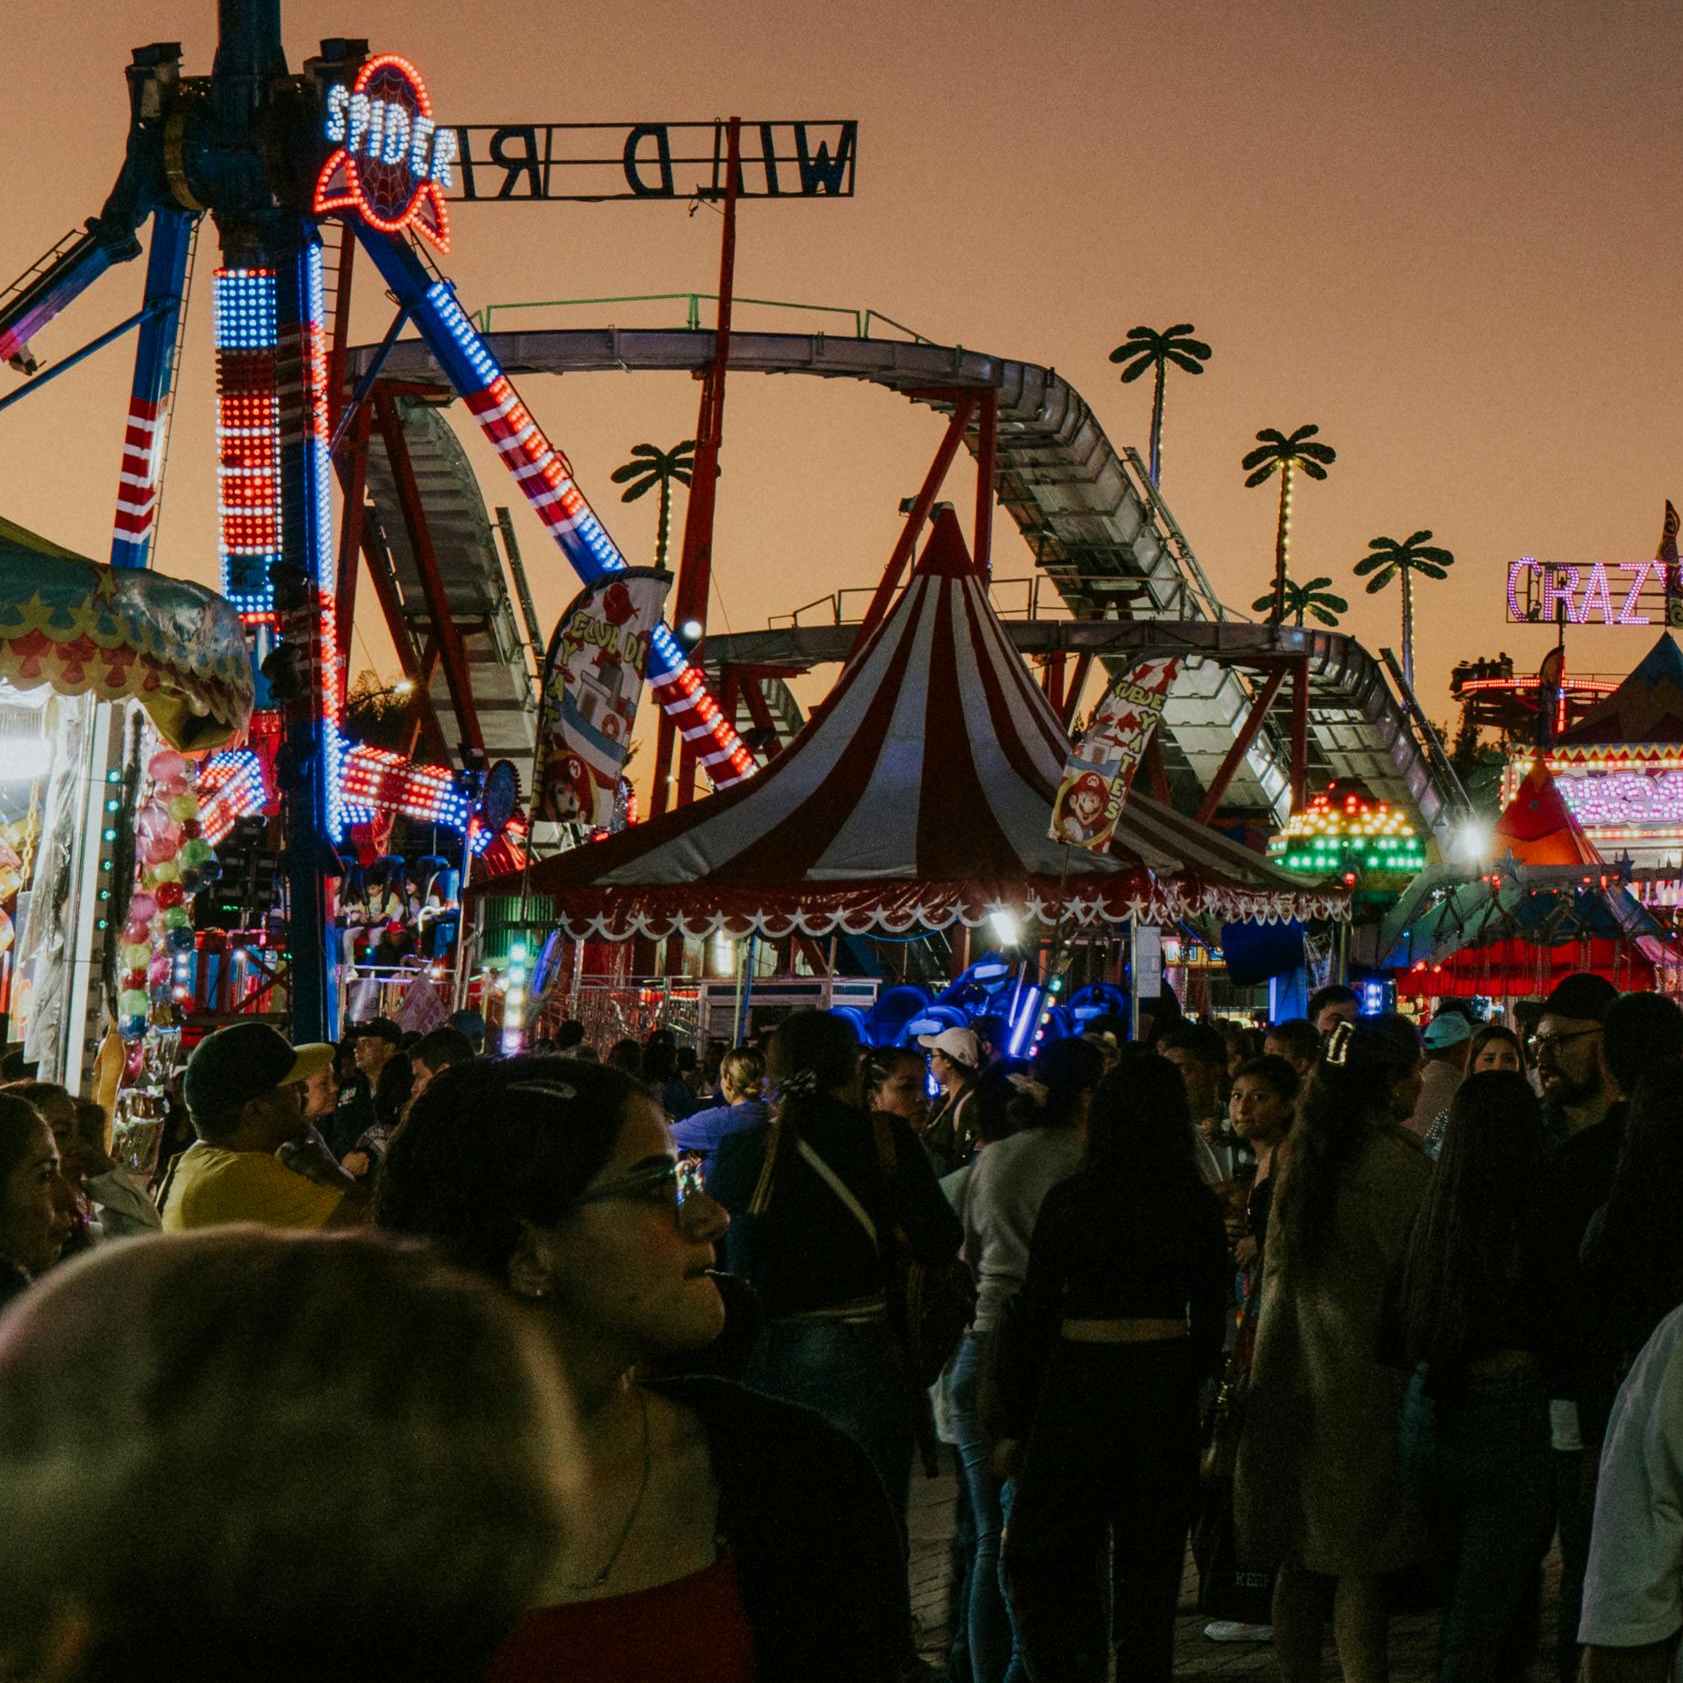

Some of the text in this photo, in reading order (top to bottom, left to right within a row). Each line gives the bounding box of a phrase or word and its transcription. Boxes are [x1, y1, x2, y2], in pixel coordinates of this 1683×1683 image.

[326, 83, 457, 188] SPIDER
[571, 611, 621, 654] CLUB
[1104, 710, 1157, 820] YATES
